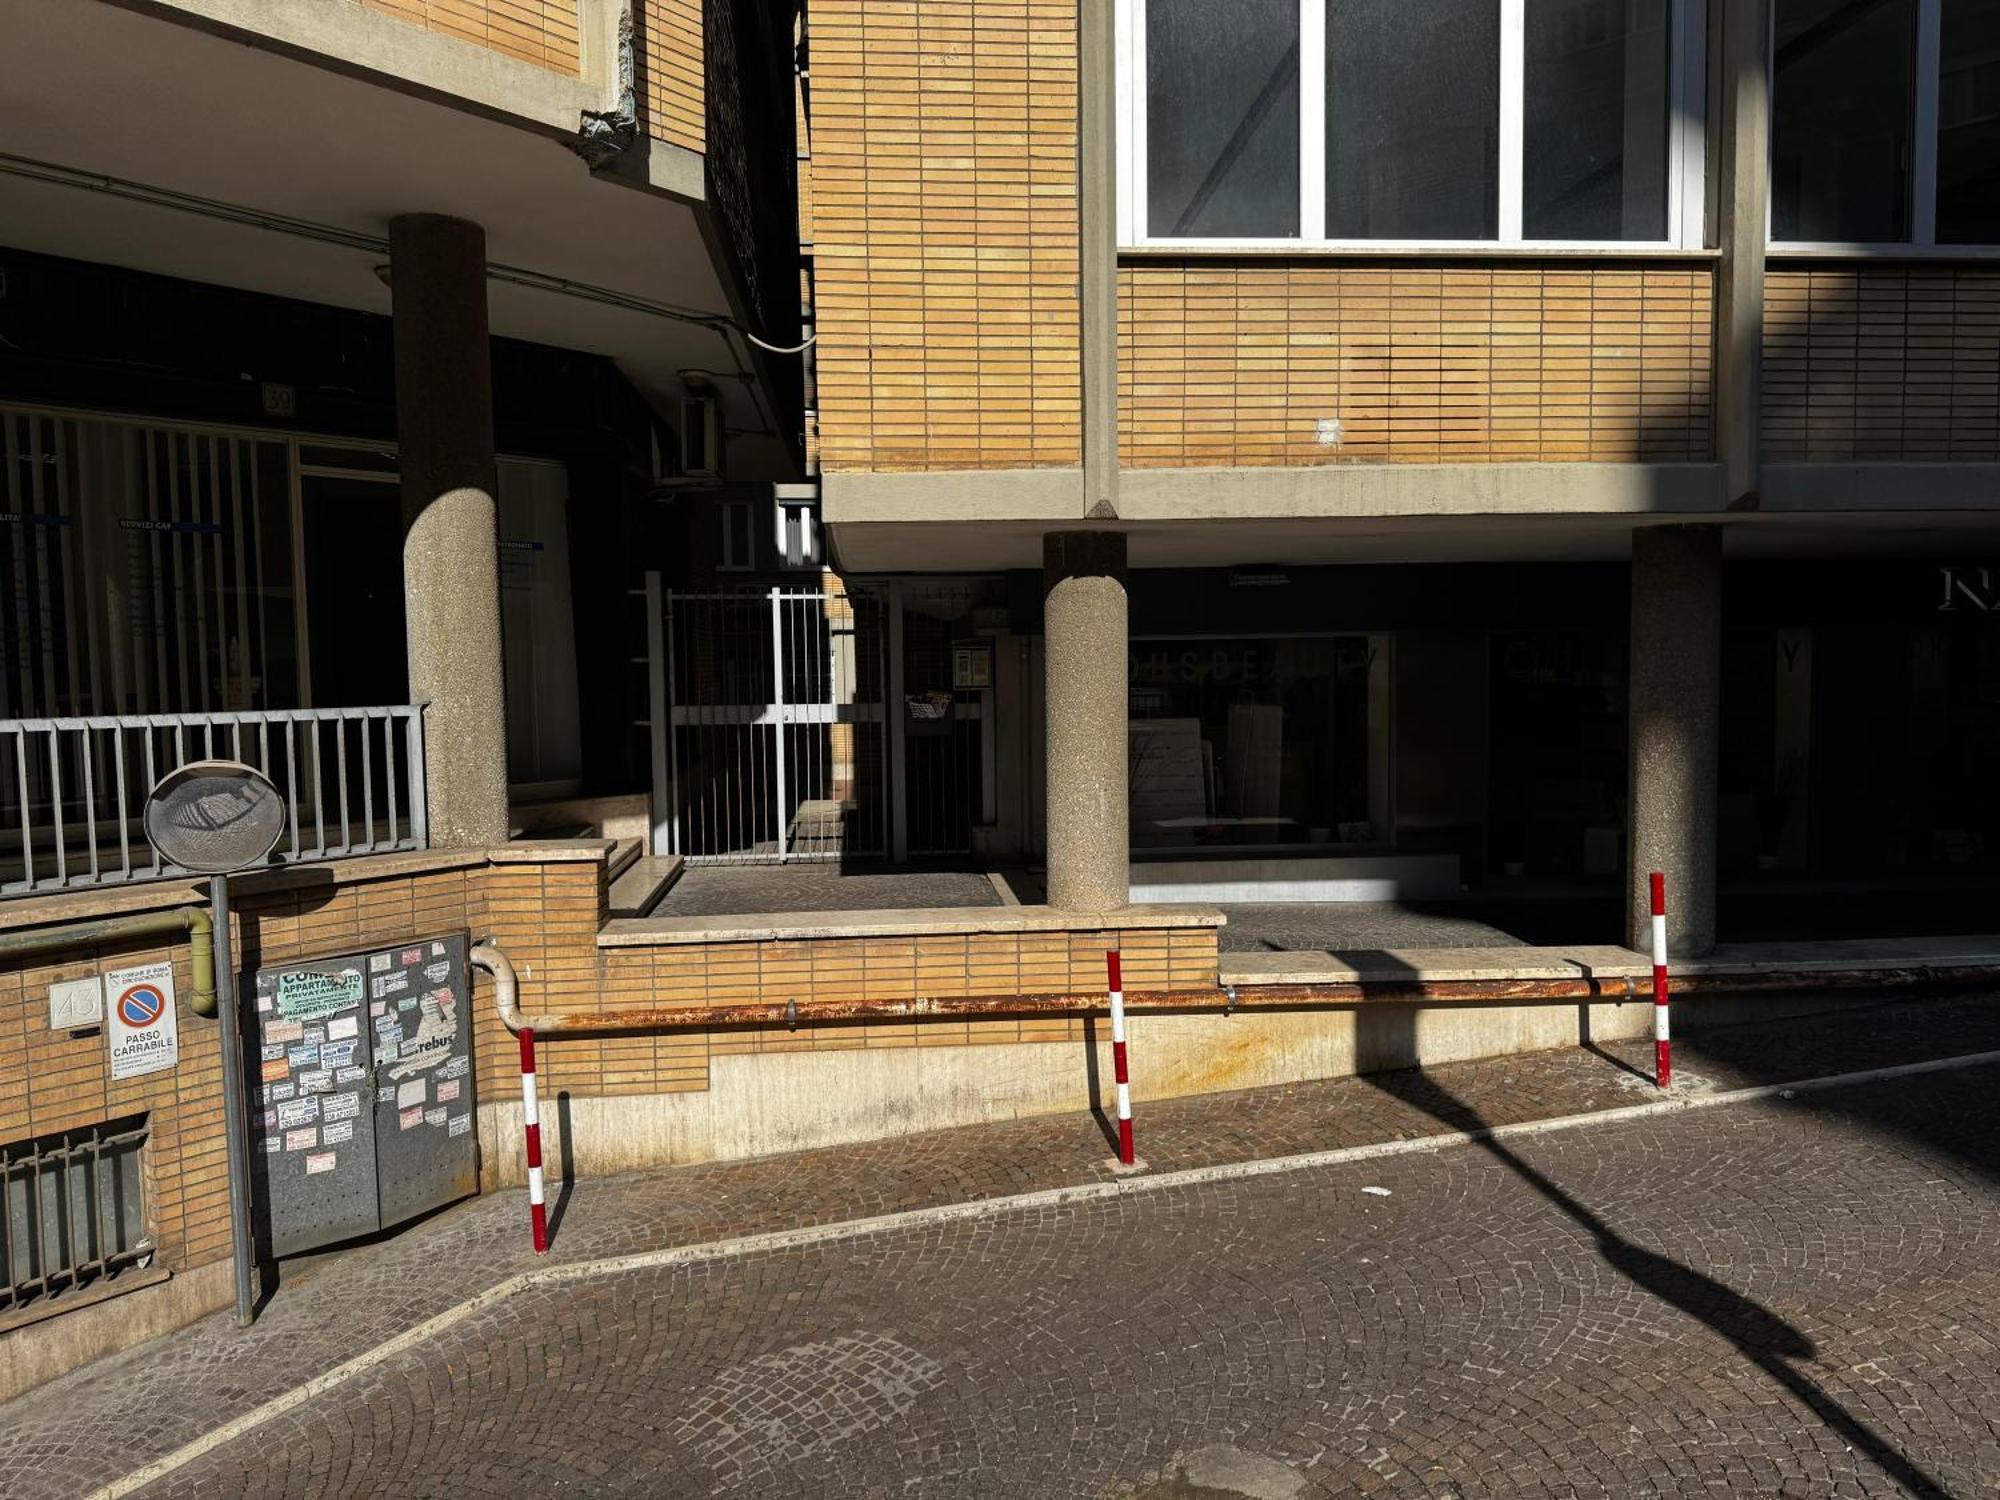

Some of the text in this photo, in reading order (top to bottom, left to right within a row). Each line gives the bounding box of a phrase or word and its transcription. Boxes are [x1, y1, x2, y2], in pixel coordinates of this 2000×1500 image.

[113, 1037, 173, 1057] CARRABILE
[126, 1030, 160, 1045] PASSO
[419, 1035, 453, 1054] rebus
